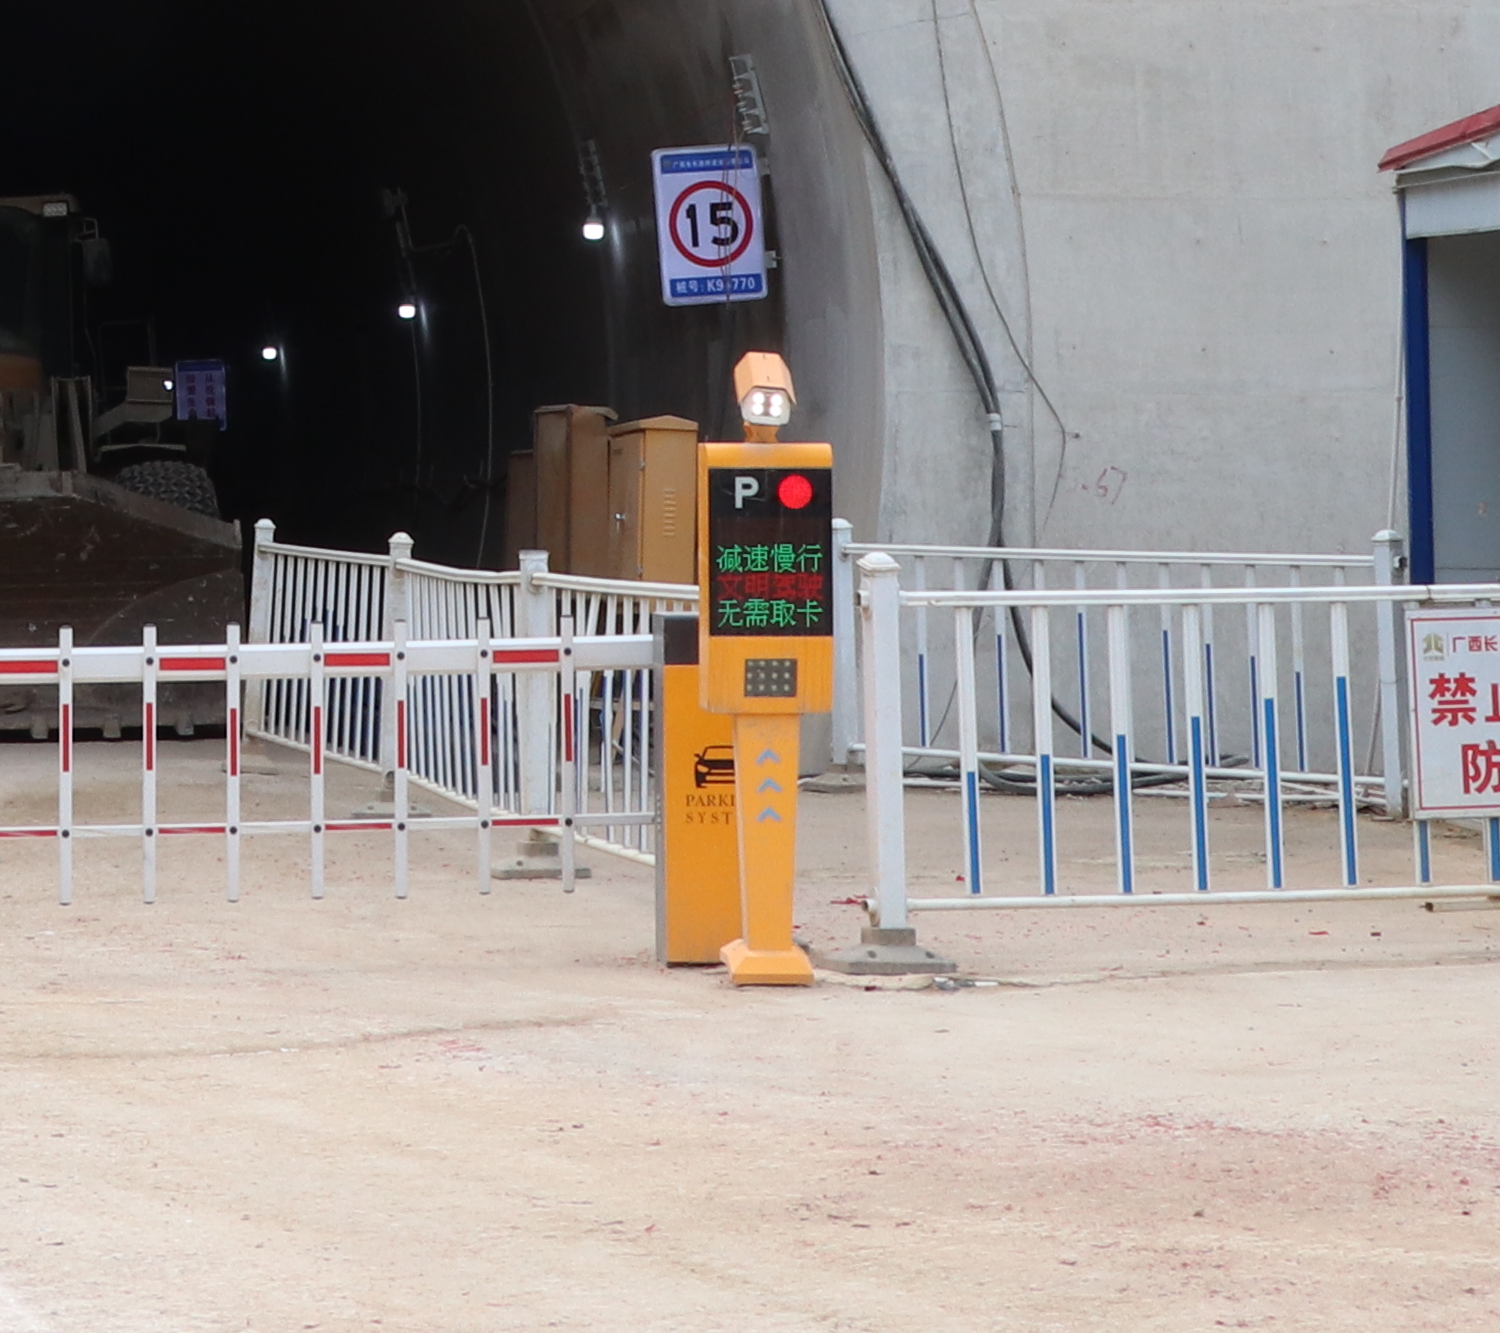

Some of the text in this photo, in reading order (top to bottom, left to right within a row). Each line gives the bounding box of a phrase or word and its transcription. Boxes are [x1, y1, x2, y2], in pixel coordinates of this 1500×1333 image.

[686, 202, 739, 248] 15
[734, 476, 760, 509] P
[716, 543, 824, 573] 减速慢行
[716, 573, 825, 601] 文明驾驶
[717, 599, 824, 627] 无需取卡
[685, 794, 735, 807] PARKI
[685, 811, 733, 825] SYST
